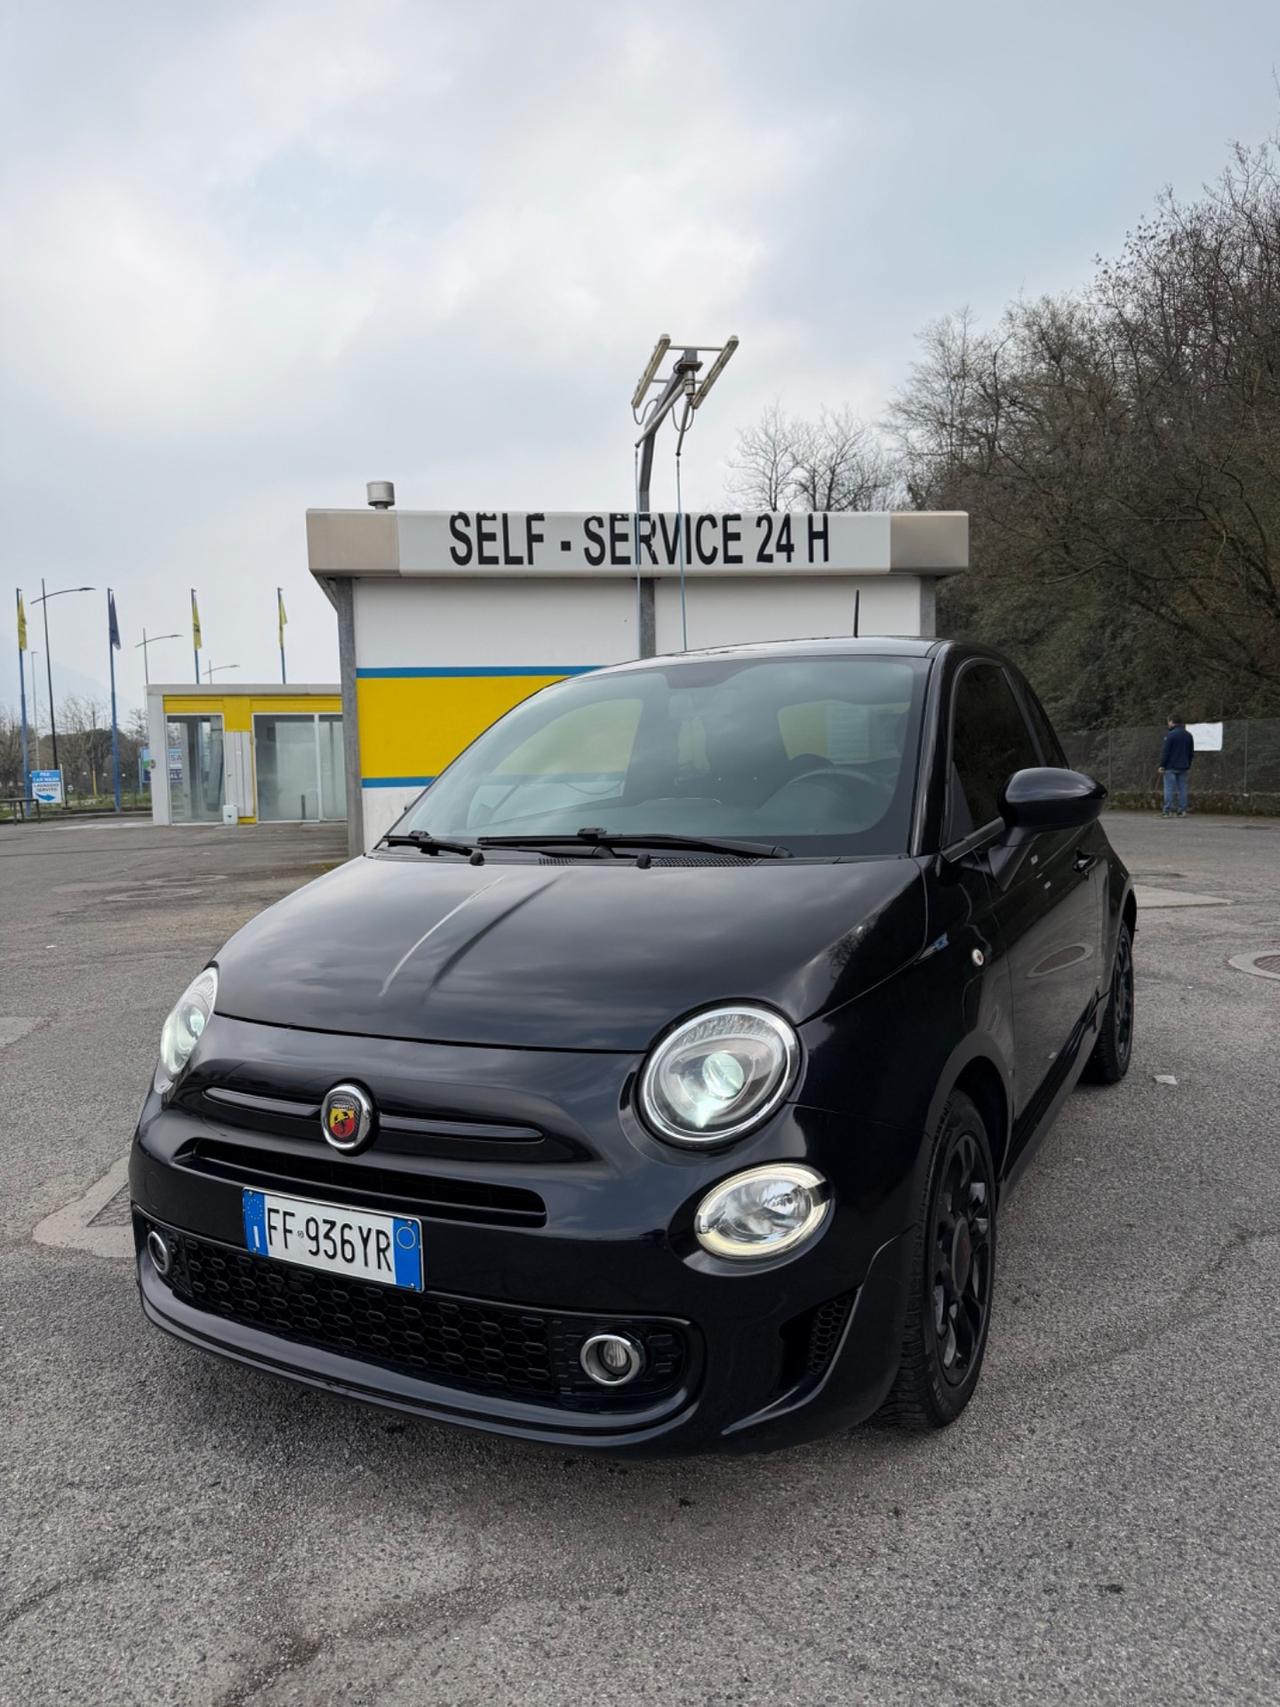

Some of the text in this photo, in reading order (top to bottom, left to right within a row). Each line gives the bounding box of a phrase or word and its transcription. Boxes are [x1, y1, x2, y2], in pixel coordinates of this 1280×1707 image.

[449, 512, 545, 565] SELF
[583, 512, 744, 565] SERVICE
[755, 513, 795, 563] 24
[808, 513, 830, 563] H
